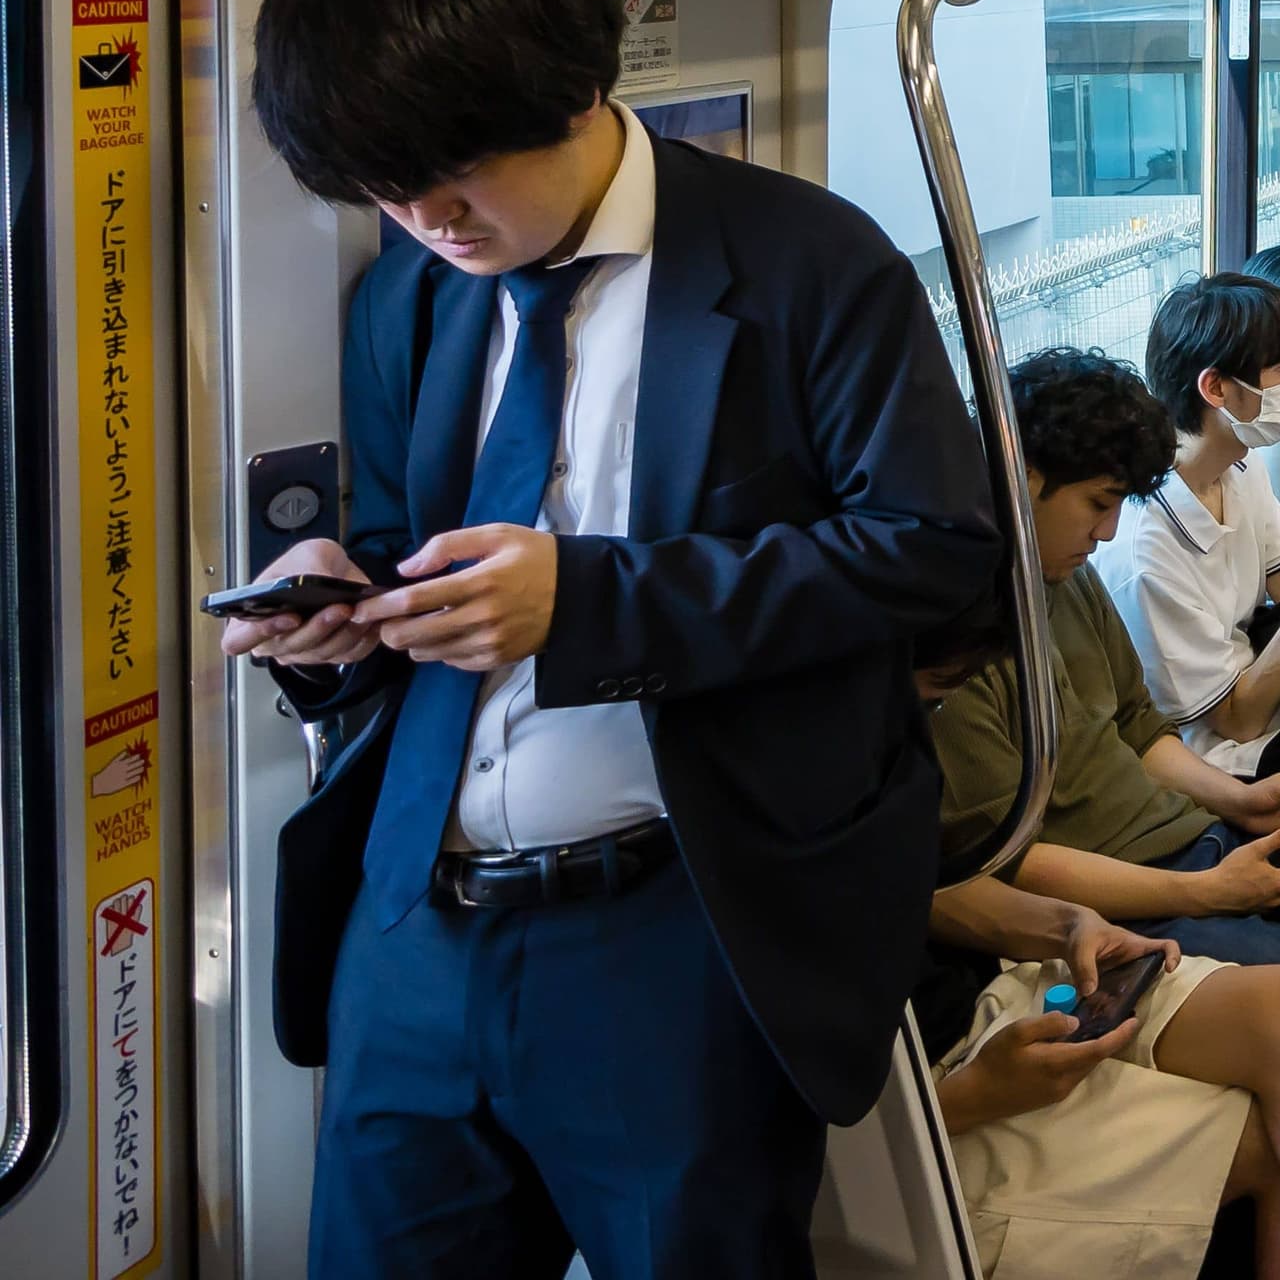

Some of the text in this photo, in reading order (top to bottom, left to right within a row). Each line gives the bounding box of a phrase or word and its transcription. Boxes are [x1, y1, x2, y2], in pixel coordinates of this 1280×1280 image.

[78, 0, 143, 19] CAUTION!
[87, 105, 136, 121] WATCH
[93, 119, 131, 135] YOUR
[79, 132, 145, 151] BAGGAGE
[101, 169, 133, 680] ドアに引き込まれないようご注意ください
[89, 699, 154, 738] CAUTION!
[95, 798, 152, 834] WATCH
[102, 814, 145, 845] YOUR
[96, 826, 151, 863] HANDS
